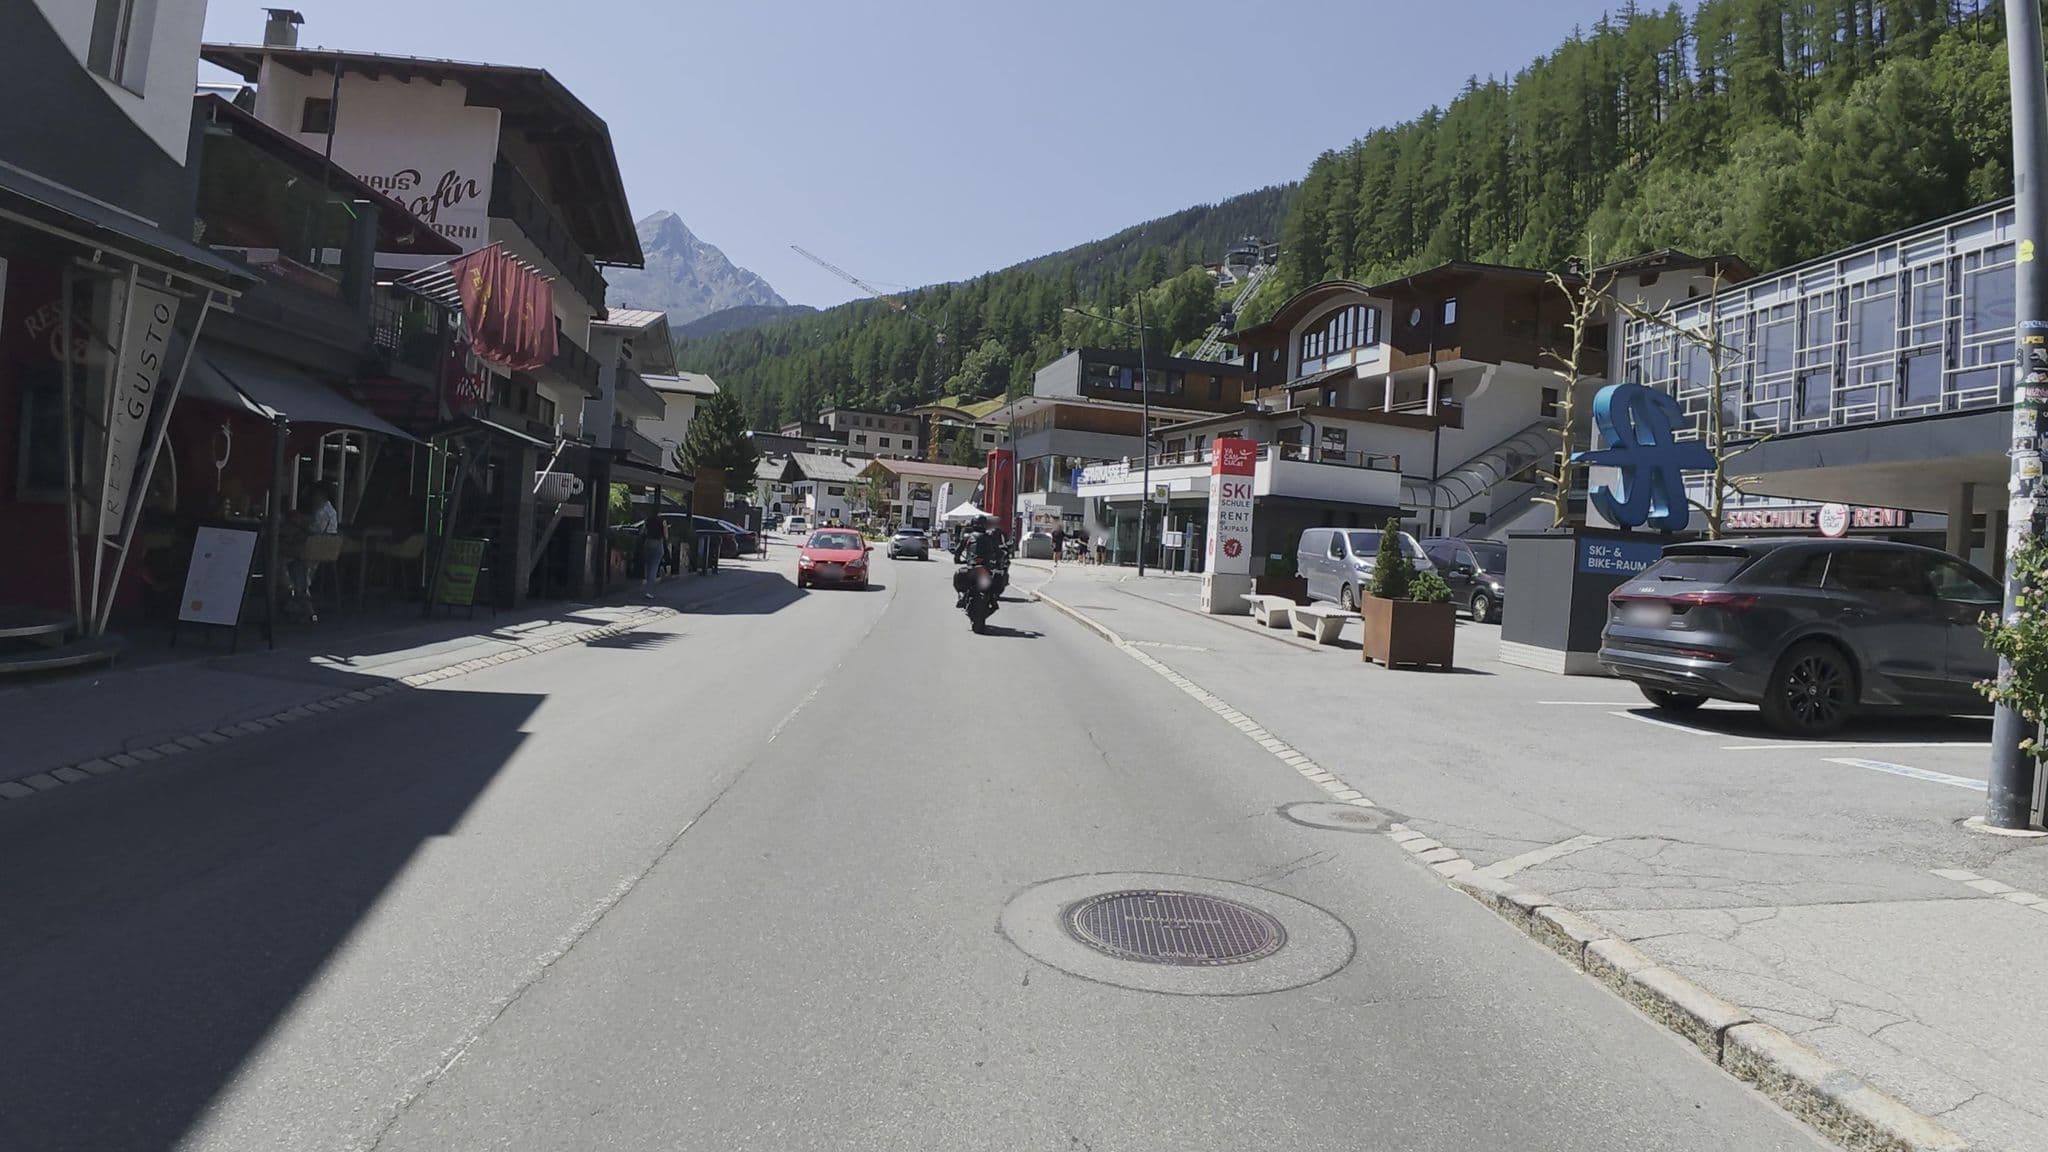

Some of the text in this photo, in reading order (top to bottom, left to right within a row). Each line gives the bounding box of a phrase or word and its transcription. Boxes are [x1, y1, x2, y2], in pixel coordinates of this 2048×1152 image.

[427, 222, 478, 239] ARNI
[127, 303, 170, 420] GUSTO
[1223, 483, 1251, 499] SKI
[1221, 500, 1251, 508] SCHULE
[1220, 512, 1249, 522] RENT
[1727, 510, 1817, 528] SKISCHULE
[1854, 508, 1906, 528] RENT
[1589, 545, 1622, 557] SKI- &
[1588, 558, 1648, 571] BIKE-RAUM
